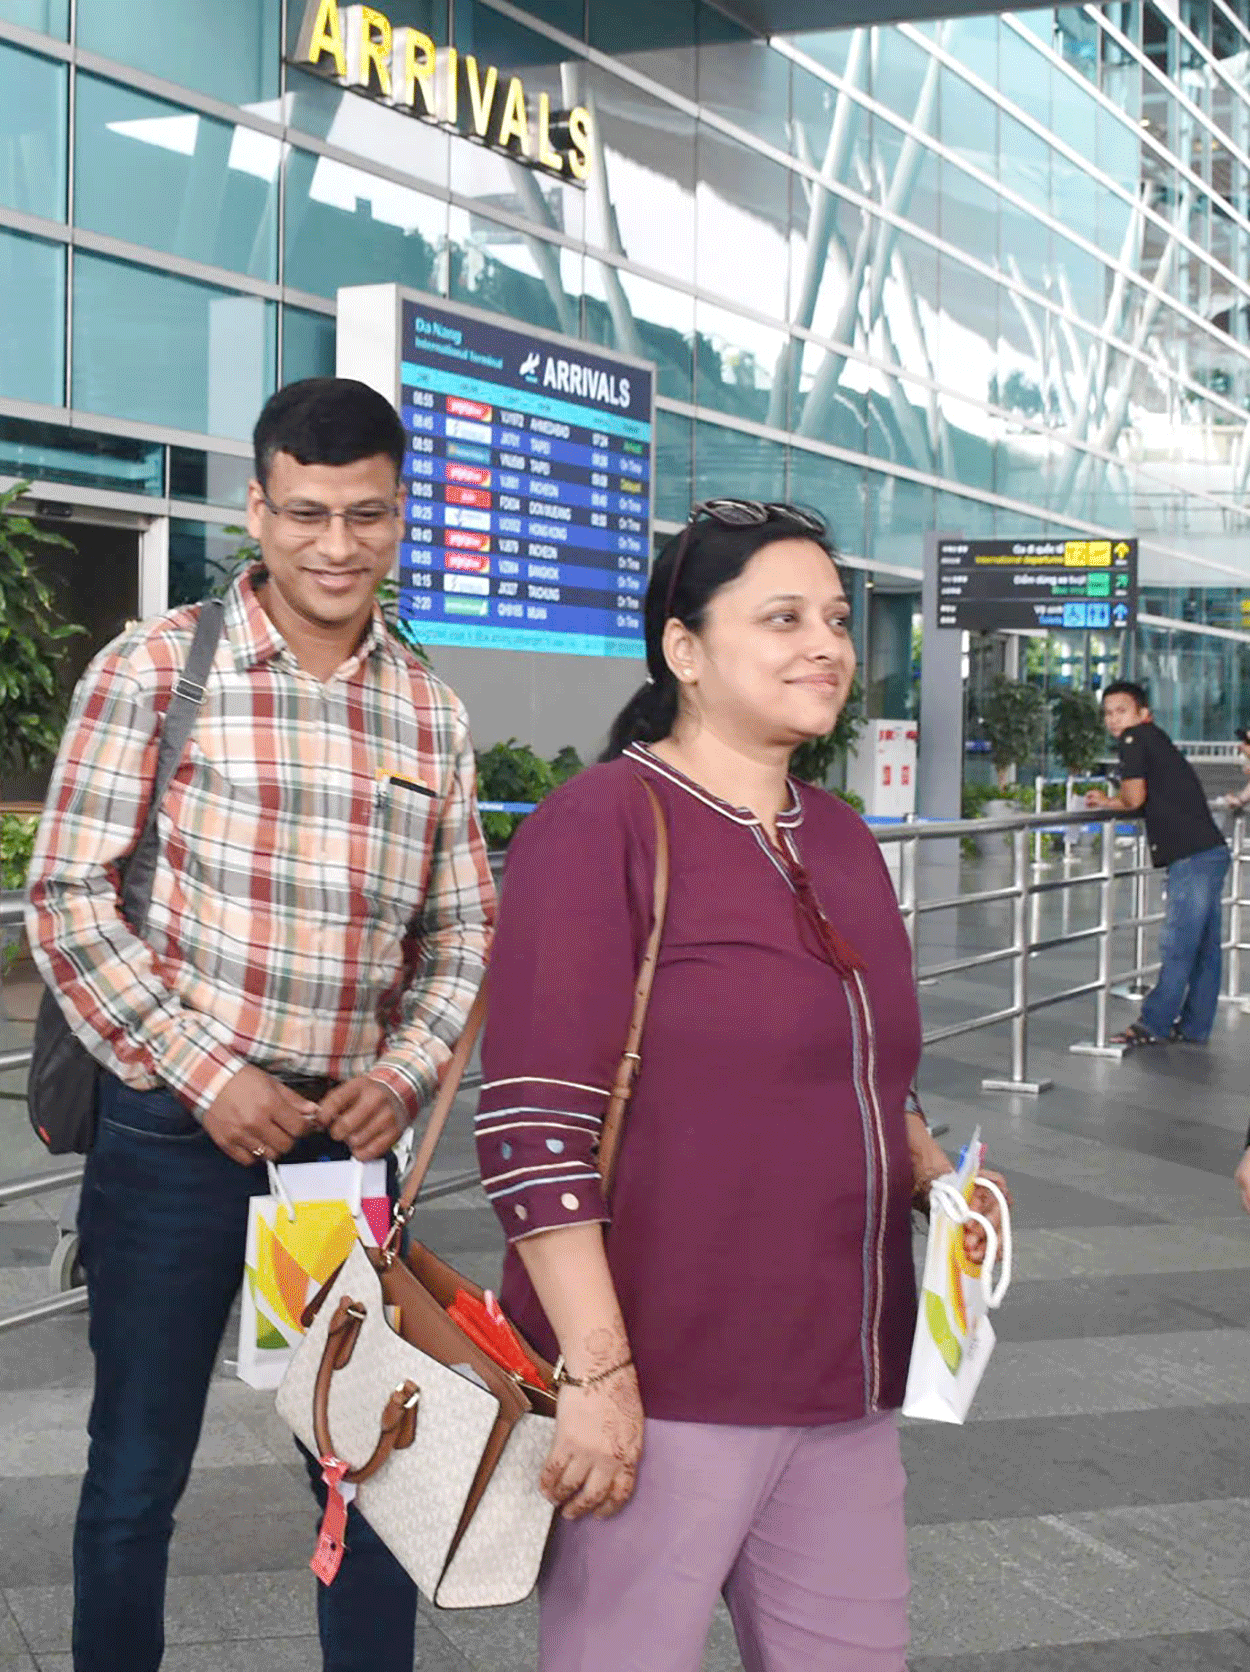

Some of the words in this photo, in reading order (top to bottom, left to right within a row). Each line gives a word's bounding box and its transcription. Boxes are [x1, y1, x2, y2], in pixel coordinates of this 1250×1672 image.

[308, 0, 591, 181] ARRIVALS
[415, 317, 431, 334] Da
[433, 321, 462, 345] Nang
[543, 357, 630, 408] ARRIVALS
